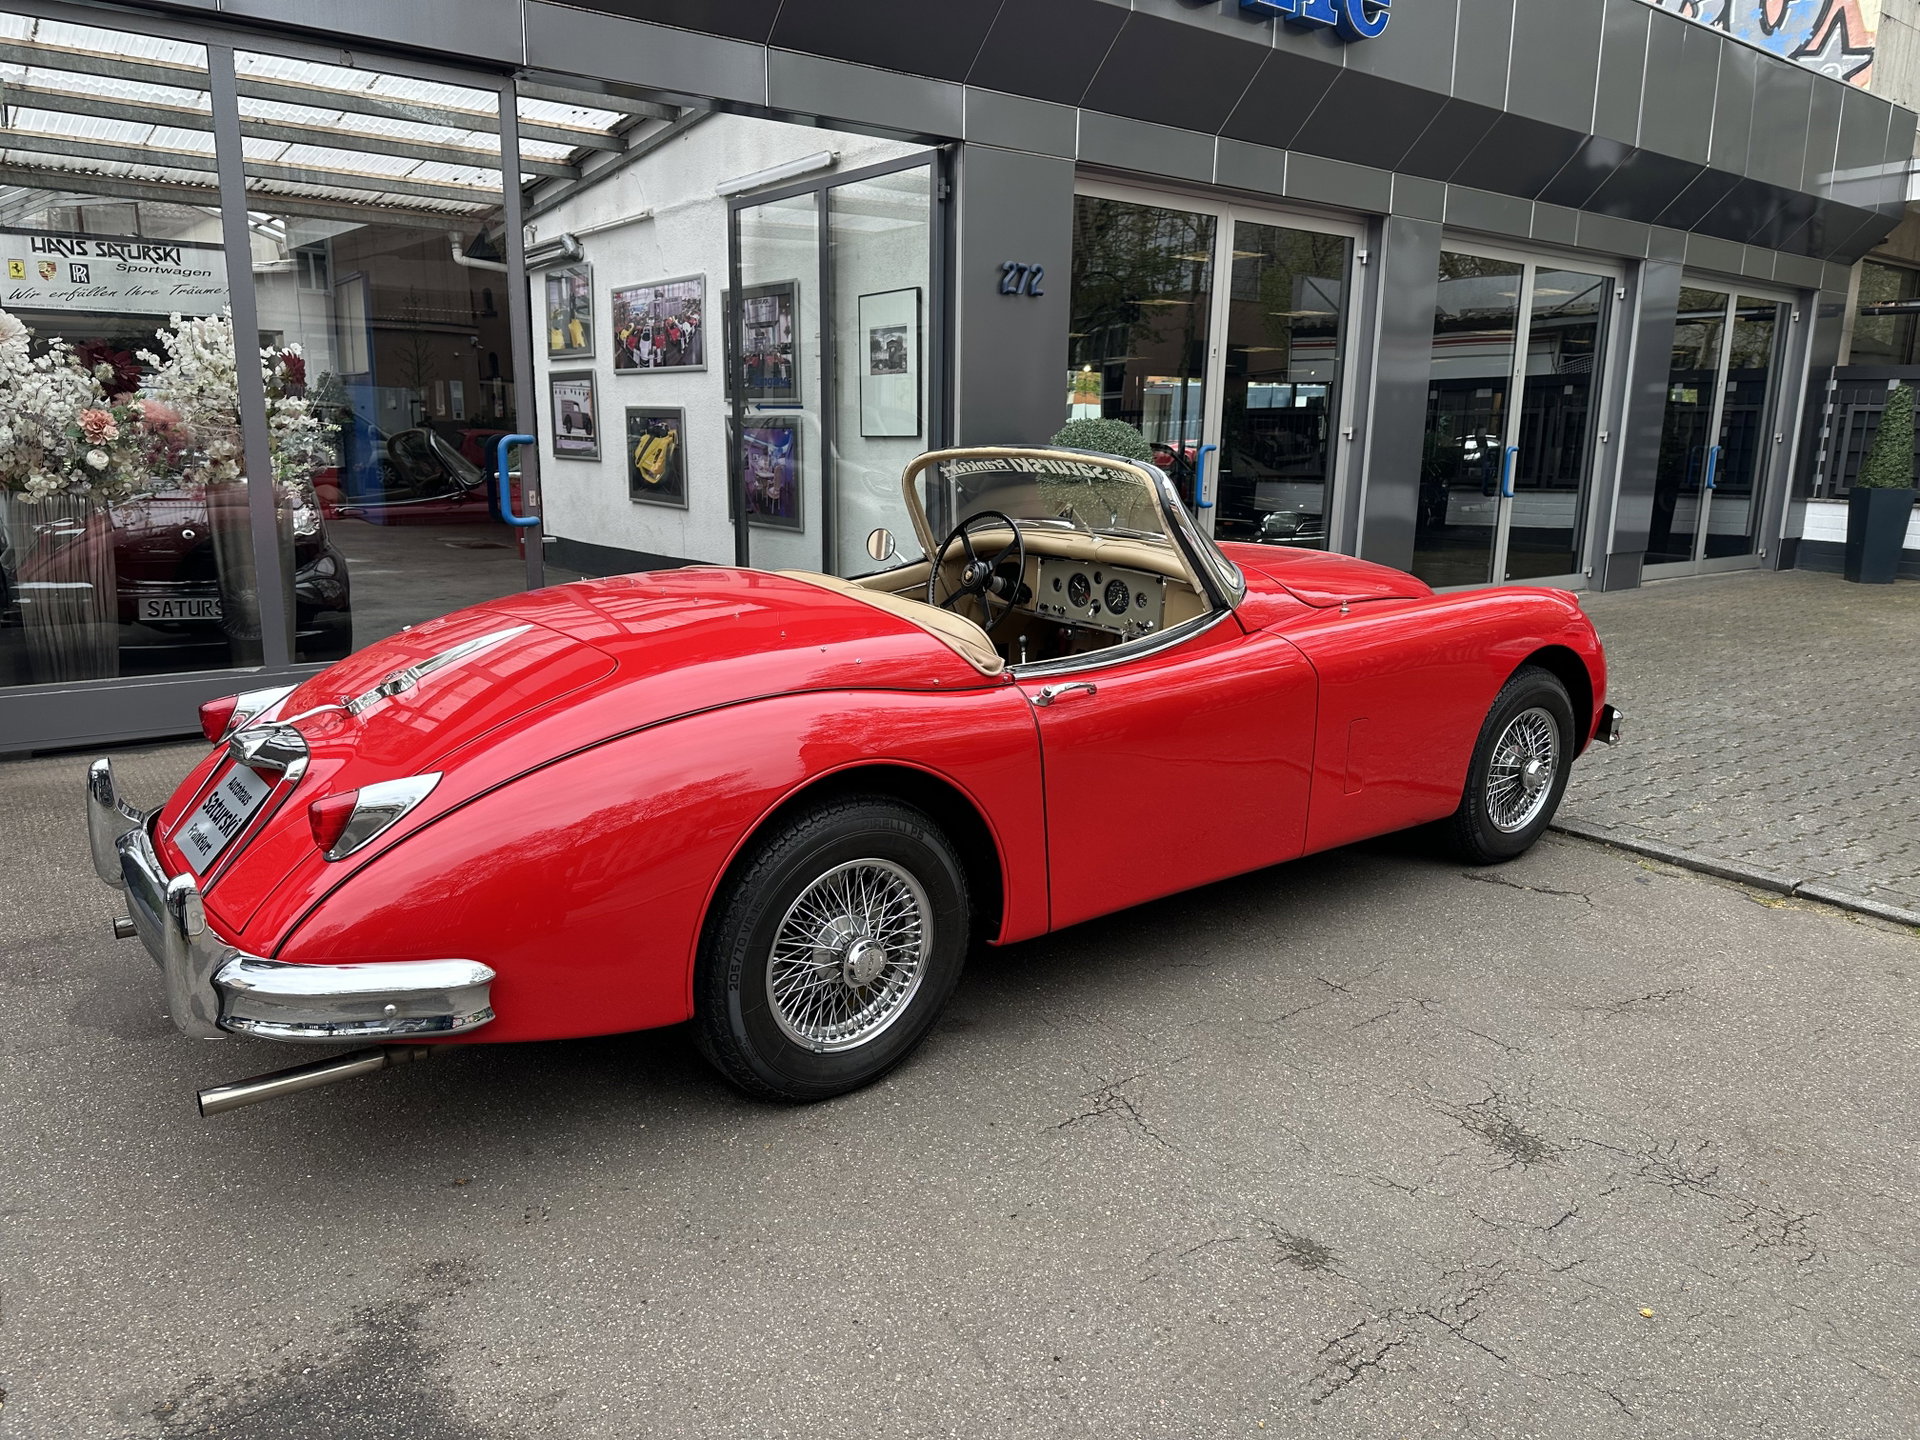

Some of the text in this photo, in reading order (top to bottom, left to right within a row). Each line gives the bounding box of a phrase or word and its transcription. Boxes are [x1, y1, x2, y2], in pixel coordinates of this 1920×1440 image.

[30, 237, 182, 266] HANS SATURSKI
[116, 263, 212, 278] Sportwagen
[1000, 260, 1044, 296] 272
[9, 287, 41, 300] Wir
[49, 286, 117, 302] erfüllen
[124, 285, 160, 297] Ihre
[226, 777, 253, 807] Autohaus
[202, 791, 243, 839] Saturski
[187, 822, 213, 857] Frankfurt
[727, 936, 749, 992] 205/70
